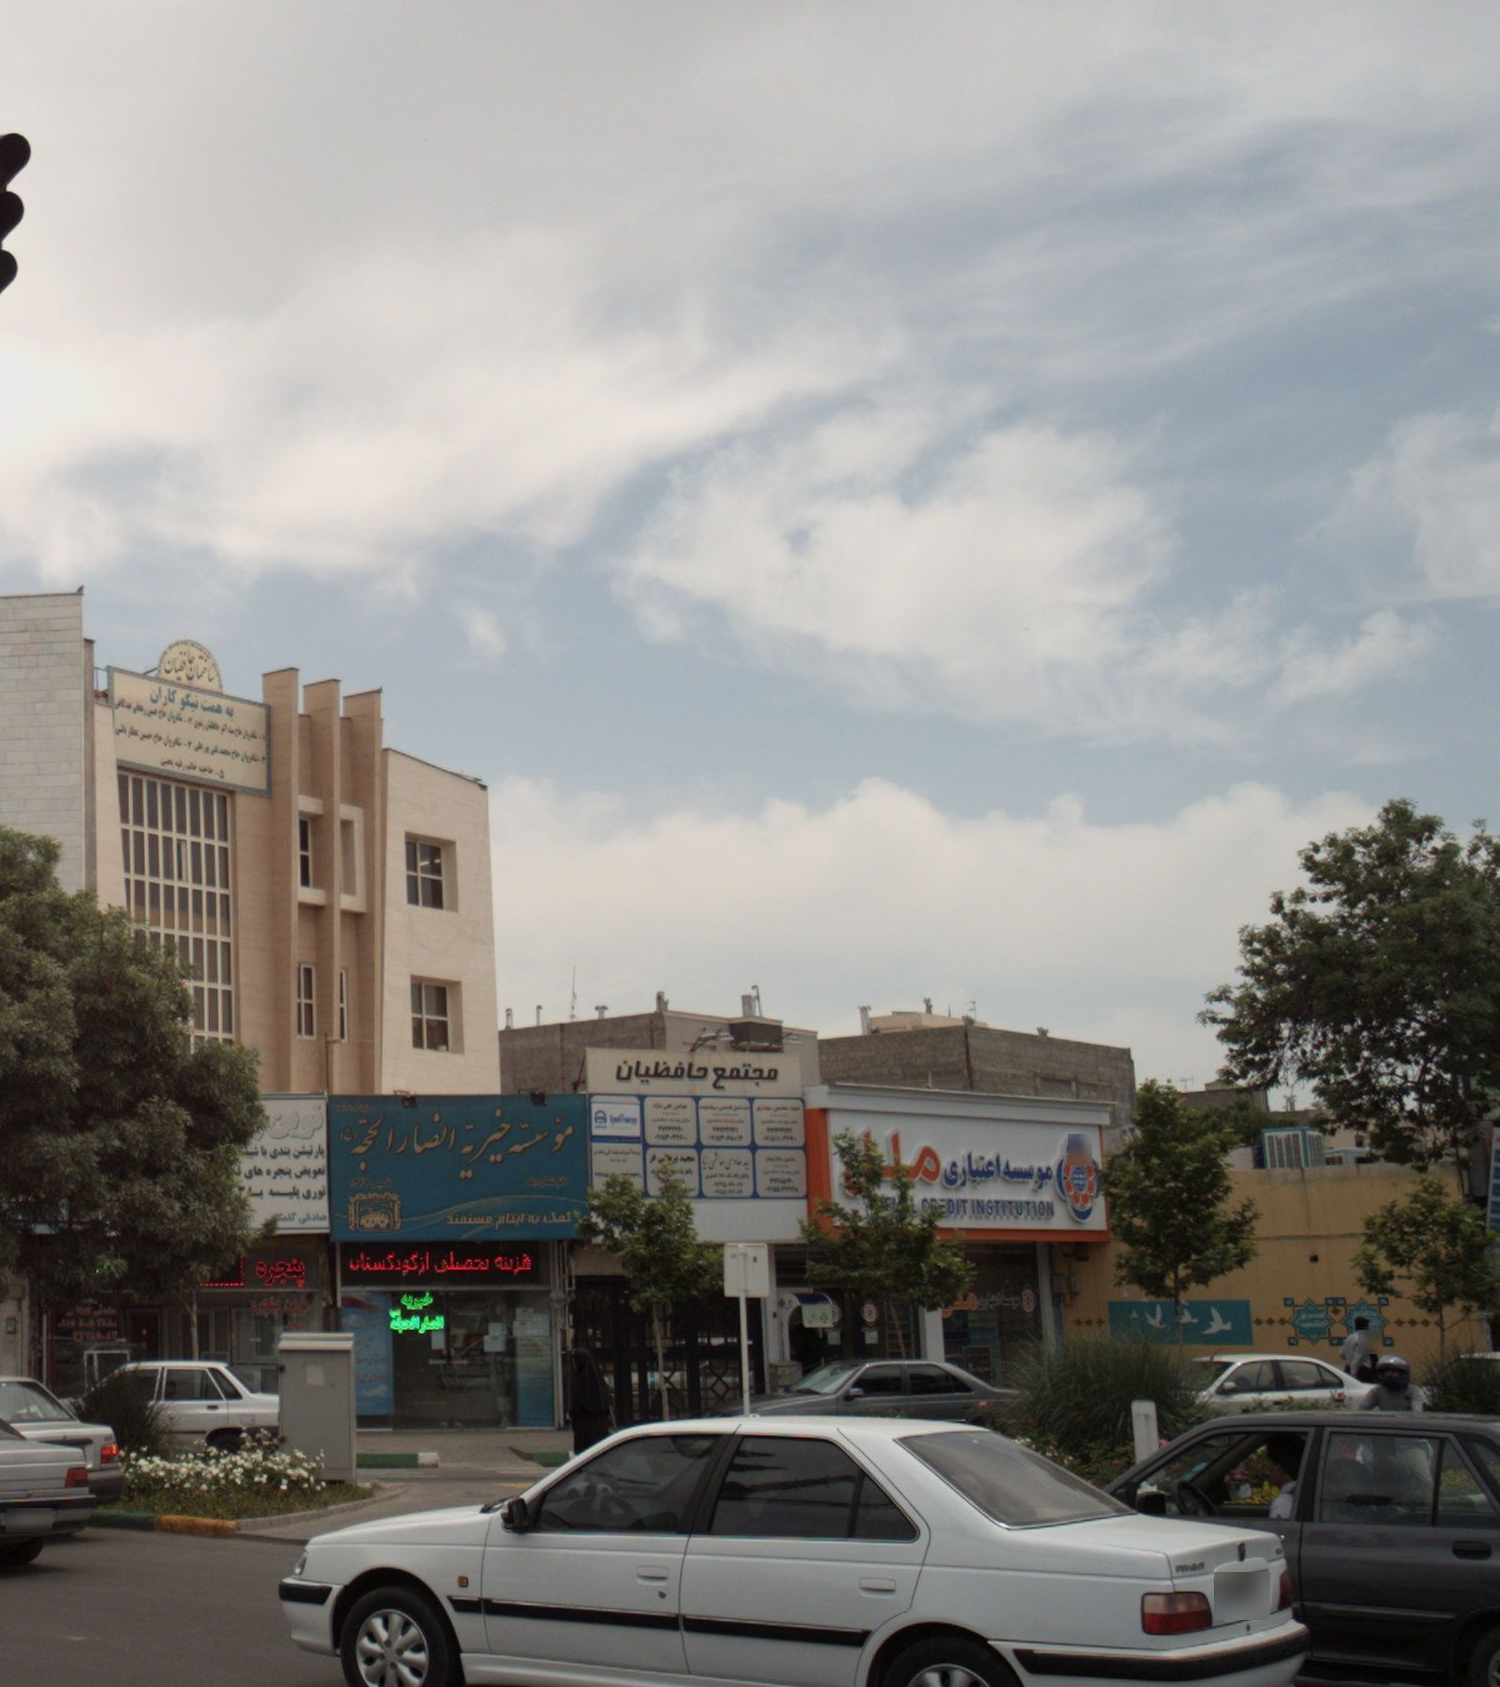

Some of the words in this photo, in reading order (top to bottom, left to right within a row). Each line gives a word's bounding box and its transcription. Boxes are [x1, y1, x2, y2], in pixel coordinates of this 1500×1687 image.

[225, 708, 235, 721] به
[616, 1059, 708, 1084] حافظیان
[711, 1062, 779, 1091] مجتمع
[269, 1146, 291, 1159] بندی
[244, 1165, 264, 1180] های
[265, 1166, 293, 1180] پنجره
[294, 1165, 326, 1179] تعویض
[943, 1152, 1001, 1188] اعتباری
[1002, 1159, 1054, 1190] موسسه
[301, 1185, 326, 1200] توری
[970, 1199, 1055, 1217] INSTITUTION
[445, 1210, 494, 1226] مستمند
[525, 1212, 541, 1226] به
[542, 1209, 574, 1225] کمک
[433, 1251, 489, 1274] تحصیلی
[493, 1253, 532, 1275] هزینه
[255, 1259, 307, 1289] پنجره
